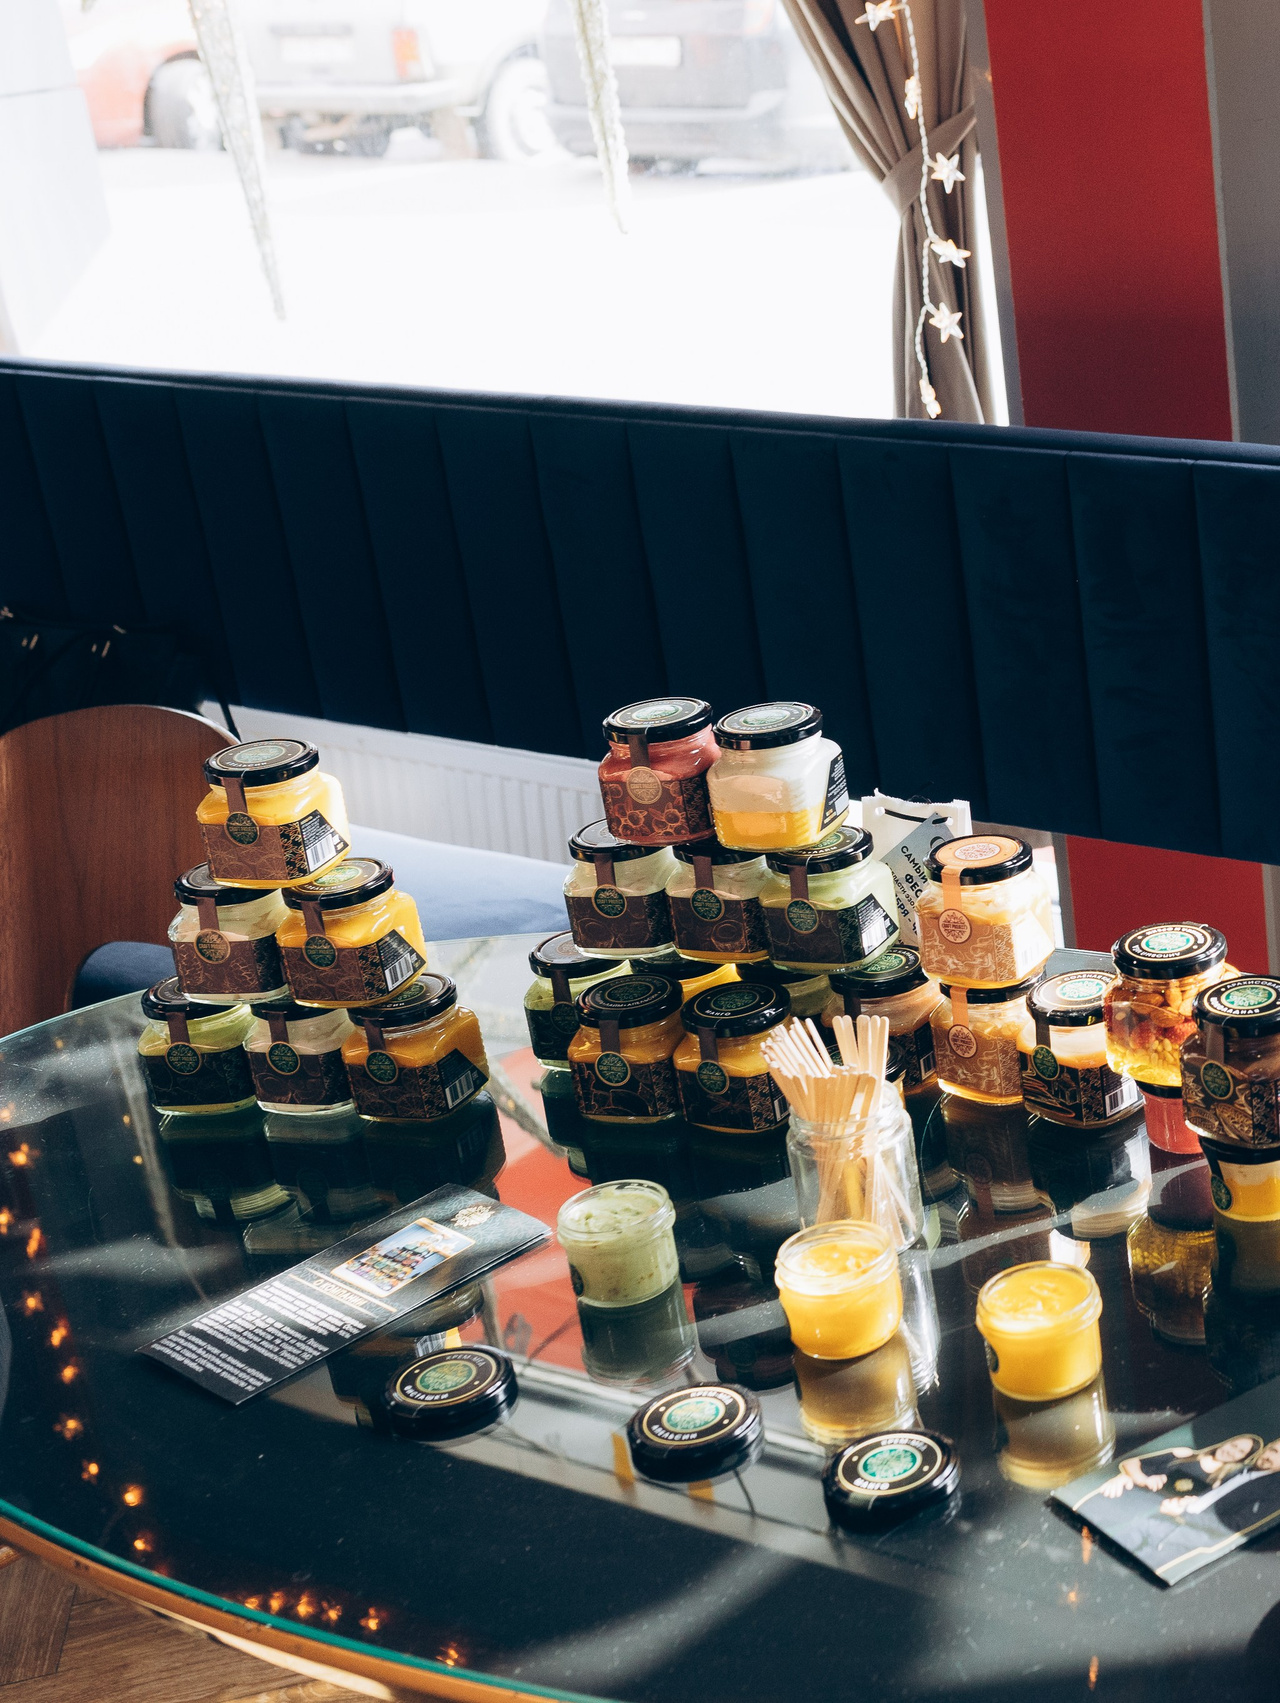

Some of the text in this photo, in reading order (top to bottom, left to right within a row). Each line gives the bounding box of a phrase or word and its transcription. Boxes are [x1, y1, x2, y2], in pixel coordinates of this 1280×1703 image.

[704, 1008, 732, 1016] МАНГО
[320, 1280, 368, 1307] КОМПАНИИ
[446, 1354, 486, 1367] КРЕМ-МЁД
[403, 1384, 449, 1401] ФИСТАШКИ
[690, 1391, 733, 1405] КРЕМ-МЁД
[651, 1424, 698, 1440] АПЕЛЬСИН
[881, 1438, 928, 1452] КРЕМ-МЁД
[853, 1477, 890, 1490] МАНГО
